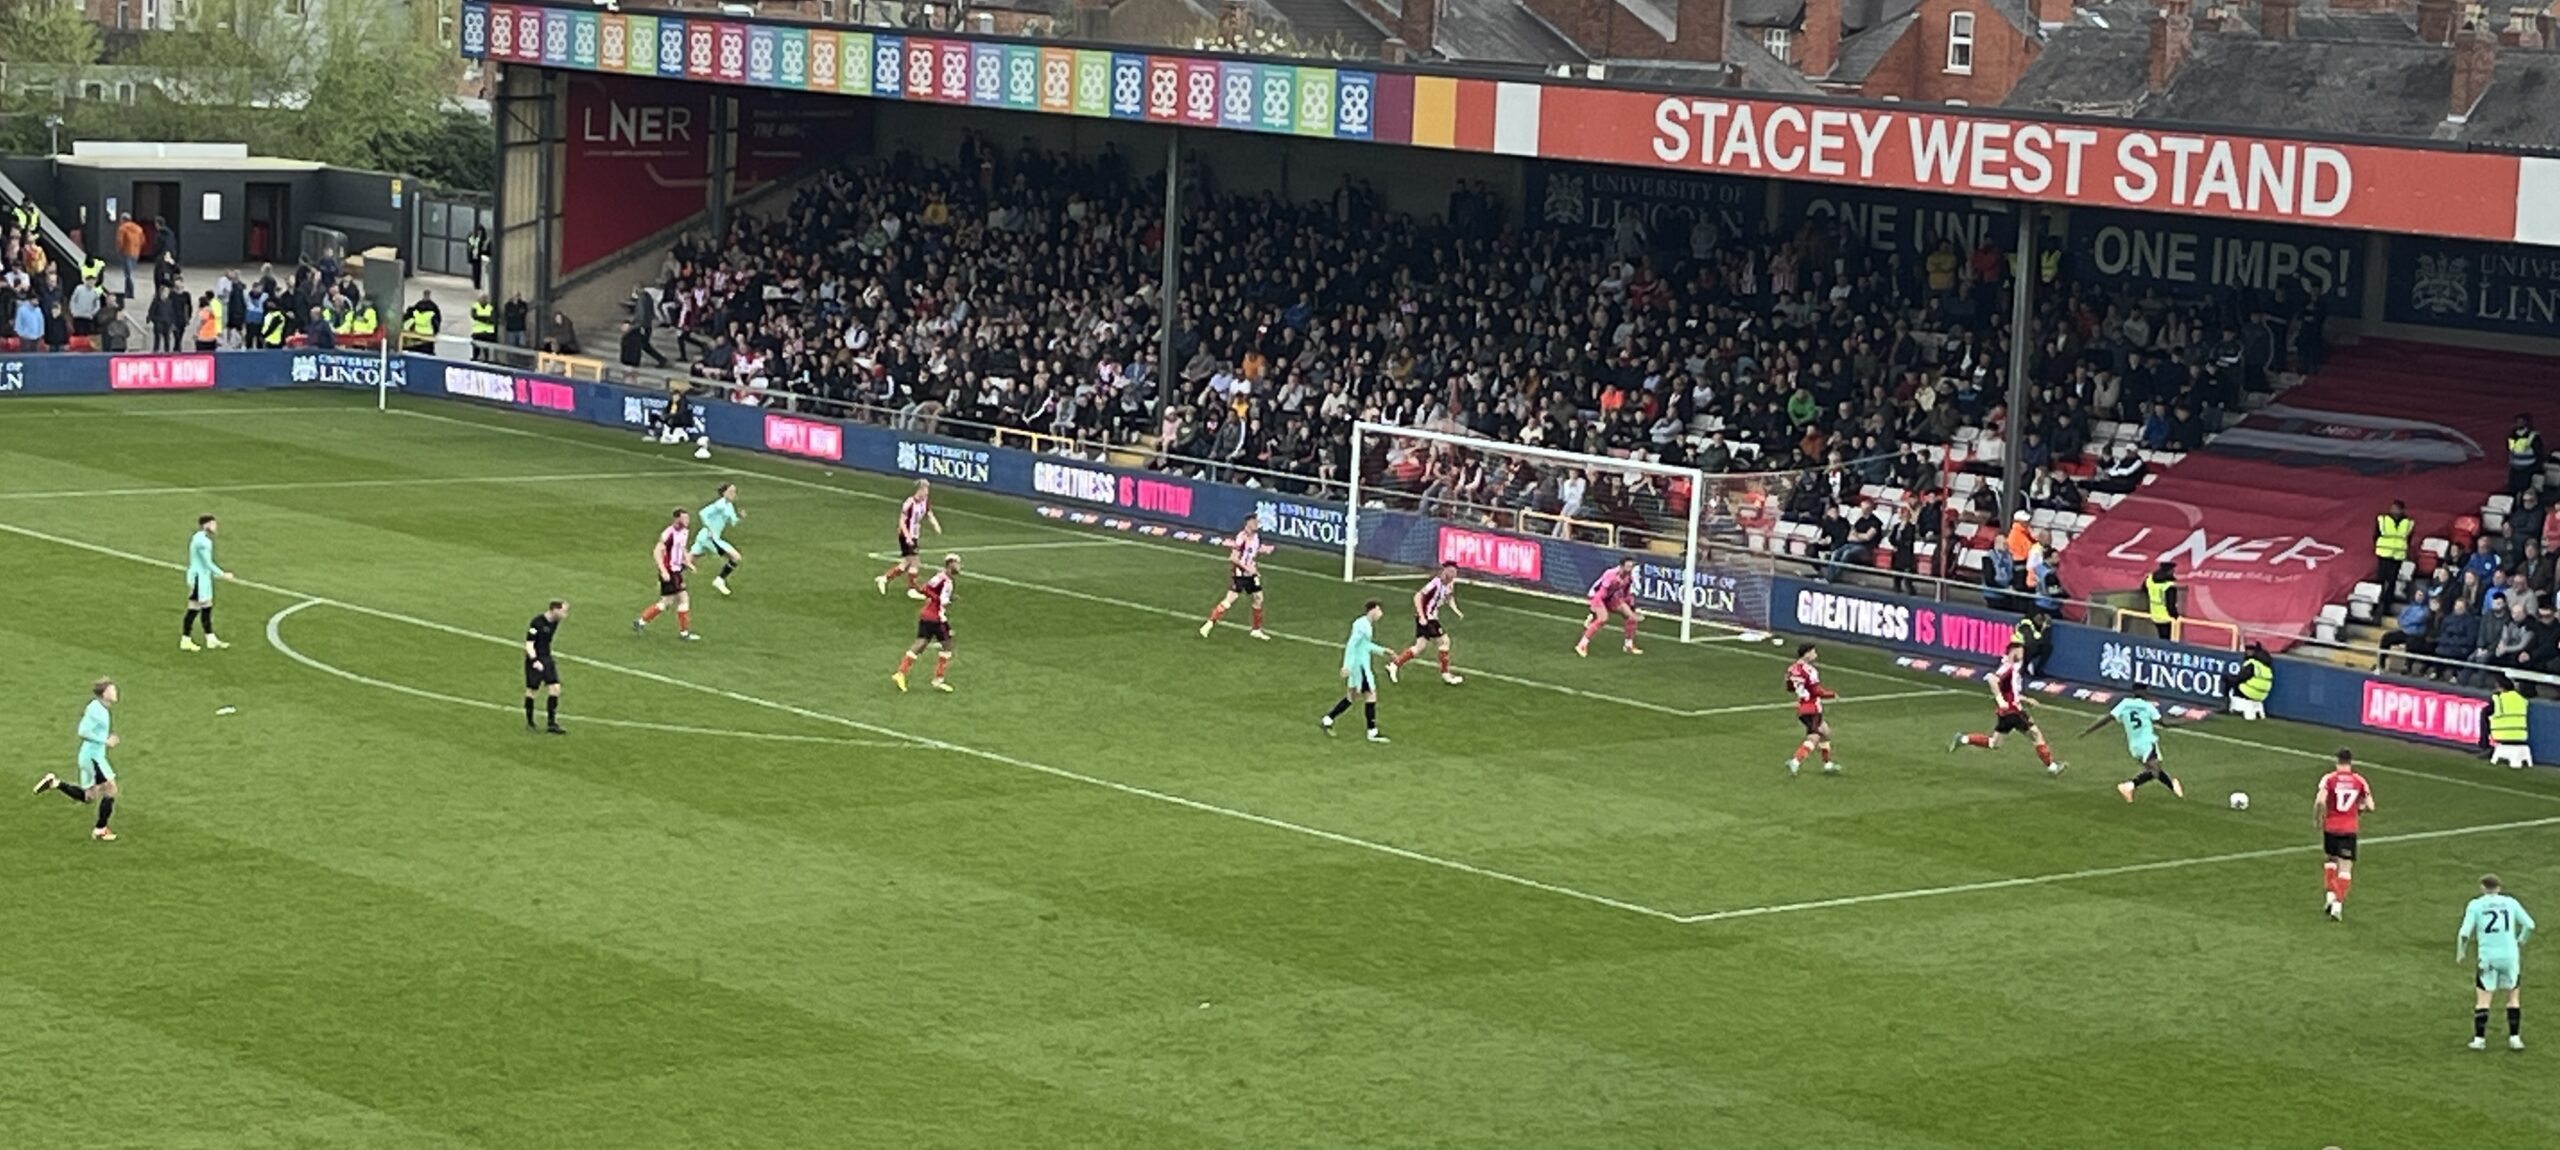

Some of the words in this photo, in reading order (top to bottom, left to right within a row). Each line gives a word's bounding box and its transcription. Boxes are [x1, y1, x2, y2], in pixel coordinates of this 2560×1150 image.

[583, 99, 692, 147] LNER
[1652, 97, 1892, 178] STACEY
[1907, 116, 2097, 195] WEST
[2113, 132, 2353, 217] STAND
[1591, 172, 1714, 202] UNIVERSITY
[1719, 184, 1744, 204] OF
[2094, 226, 2197, 282] ONE
[2211, 236, 2350, 297] IMPS!
[918, 454, 989, 482] LINCOLN
[1034, 461, 1115, 504] GREATNESS
[1119, 476, 1135, 507] IS
[1279, 515, 1358, 545] LINCOL
[2107, 527, 2345, 569] LNER
[1444, 532, 1495, 566] APPLY
[1497, 541, 1535, 574] NOW
[1797, 589, 1909, 641] GREATNESS
[1914, 608, 1936, 646] IS
[2135, 645, 2225, 673] UNIVERSITY
[2134, 661, 2225, 698] LINCOL
[2130, 710, 2142, 730] 5
[2368, 688, 2439, 731] APPLY
[2334, 788, 2360, 813] 17
[2482, 909, 2510, 934] 21
